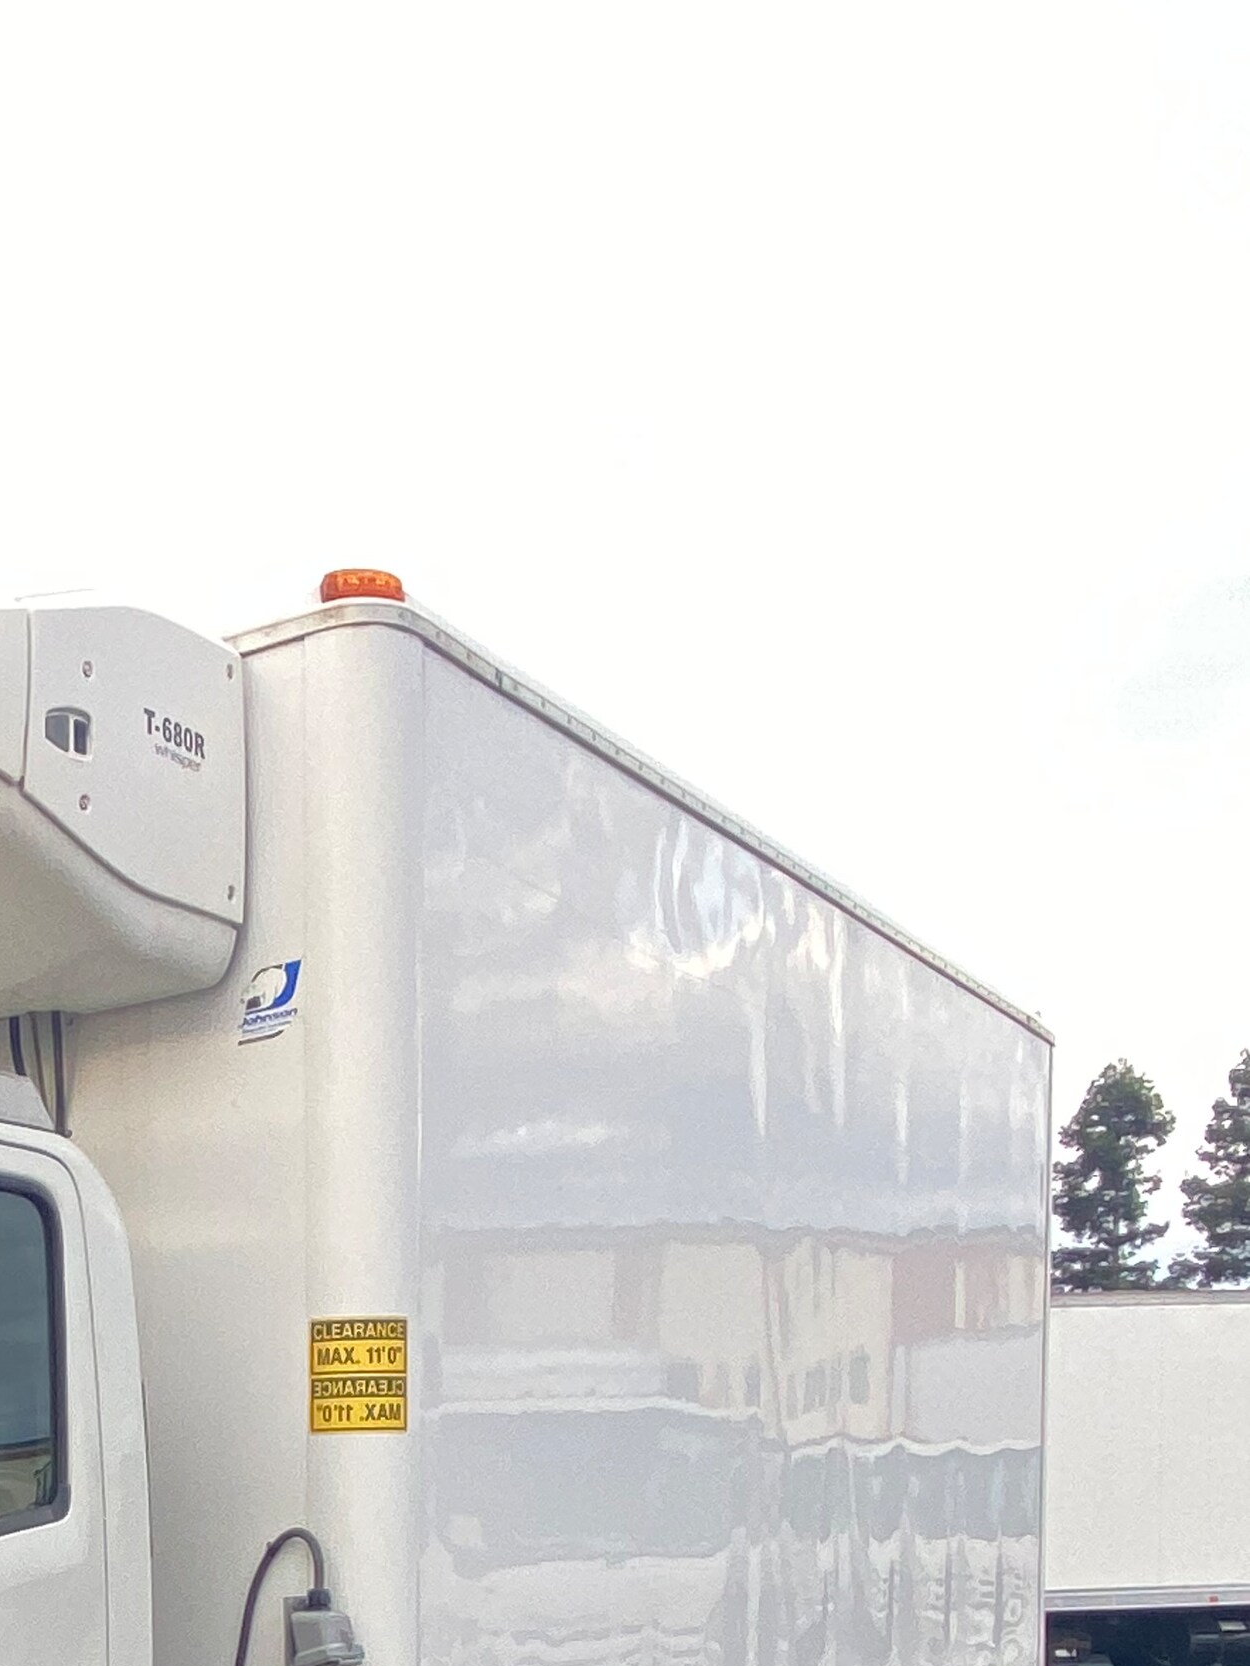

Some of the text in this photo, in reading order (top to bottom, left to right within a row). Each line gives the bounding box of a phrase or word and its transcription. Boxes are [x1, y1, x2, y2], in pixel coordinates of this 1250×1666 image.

[143, 707, 205, 759] T-680R
[313, 1322, 404, 1339] CLEARANCE
[317, 1346, 361, 1365] MAX.
